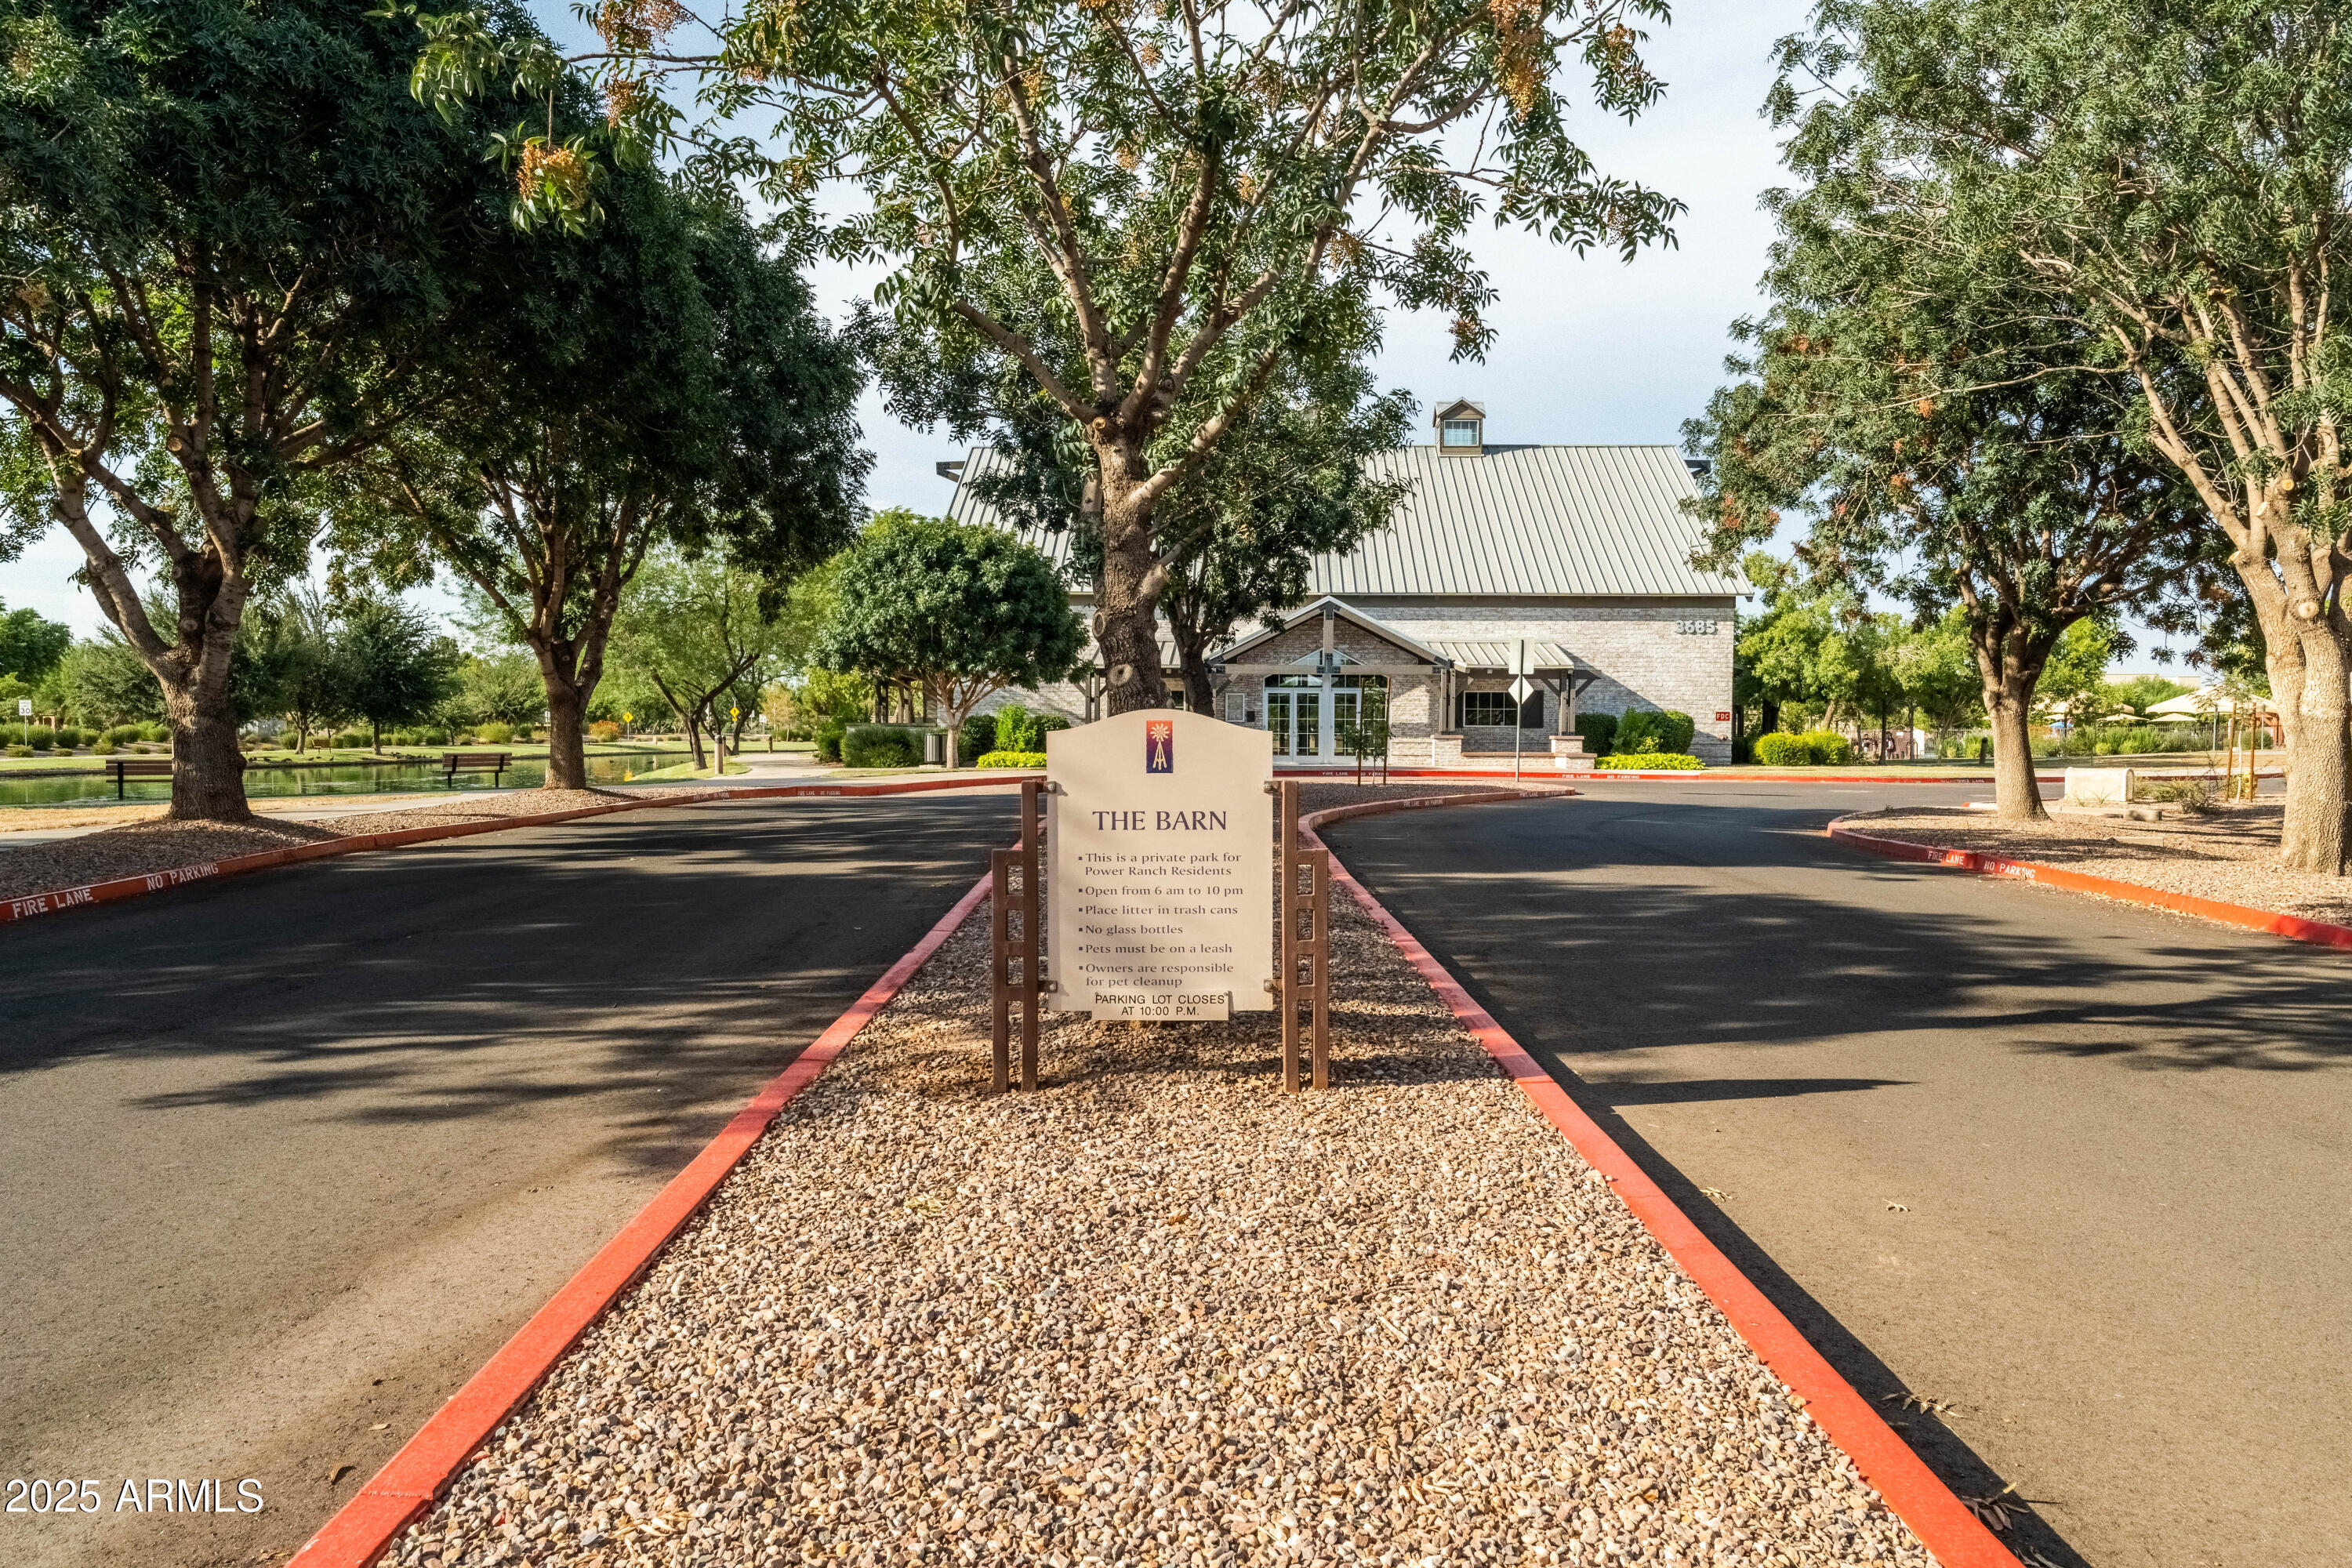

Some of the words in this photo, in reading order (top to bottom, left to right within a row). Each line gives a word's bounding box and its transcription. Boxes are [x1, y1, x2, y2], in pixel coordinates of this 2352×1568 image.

[1675, 620, 1715, 633] 3685
[1092, 811, 1145, 830] THE
[1156, 811, 1226, 830] BARN
[1085, 853, 1112, 862] This
[1116, 853, 1126, 862] is
[1142, 853, 1185, 864] private
[1191, 853, 1218, 864] park
[1223, 852, 1241, 862] for
[1927, 851, 1943, 861] FIRE
[1945, 855, 1965, 866] LANE
[1984, 860, 1995, 870] NO
[1129, 866, 1166, 875] Ranch
[1172, 866, 1231, 875] Residents
[12, 897, 49, 919] FIRE
[54, 887, 93, 909] LANE
[147, 875, 164, 891] NO
[168, 862, 219, 885] PARKING
[1086, 887, 1116, 897] Open
[1123, 886, 1150, 895] from
[1207, 886, 1220, 895] 10
[1225, 888, 1243, 897] pm
[1086, 906, 1117, 914] Place
[1123, 906, 1153, 914] litter
[1159, 906, 1169, 914] in
[1174, 906, 1205, 914] trash
[1086, 925, 1102, 934] No
[1107, 925, 1136, 936] glass
[1141, 925, 1182, 934] bottles
[1151, 944, 1165, 953] be
[1201, 944, 1232, 953] leash
[1086, 964, 1133, 972] Owners
[1162, 964, 1233, 975] responsible
[1087, 977, 1104, 985] for
[1109, 978, 1128, 988] pet
[1134, 977, 1182, 988] cleanup
[1095, 994, 1145, 1004] PARKING
[1152, 995, 1172, 1004] LOT
[1178, 994, 1225, 1004] CLOSES
[1121, 1007, 1134, 1015] AT
[1140, 1007, 1169, 1015] 10:00
[1176, 1007, 1199, 1015] P.M.
